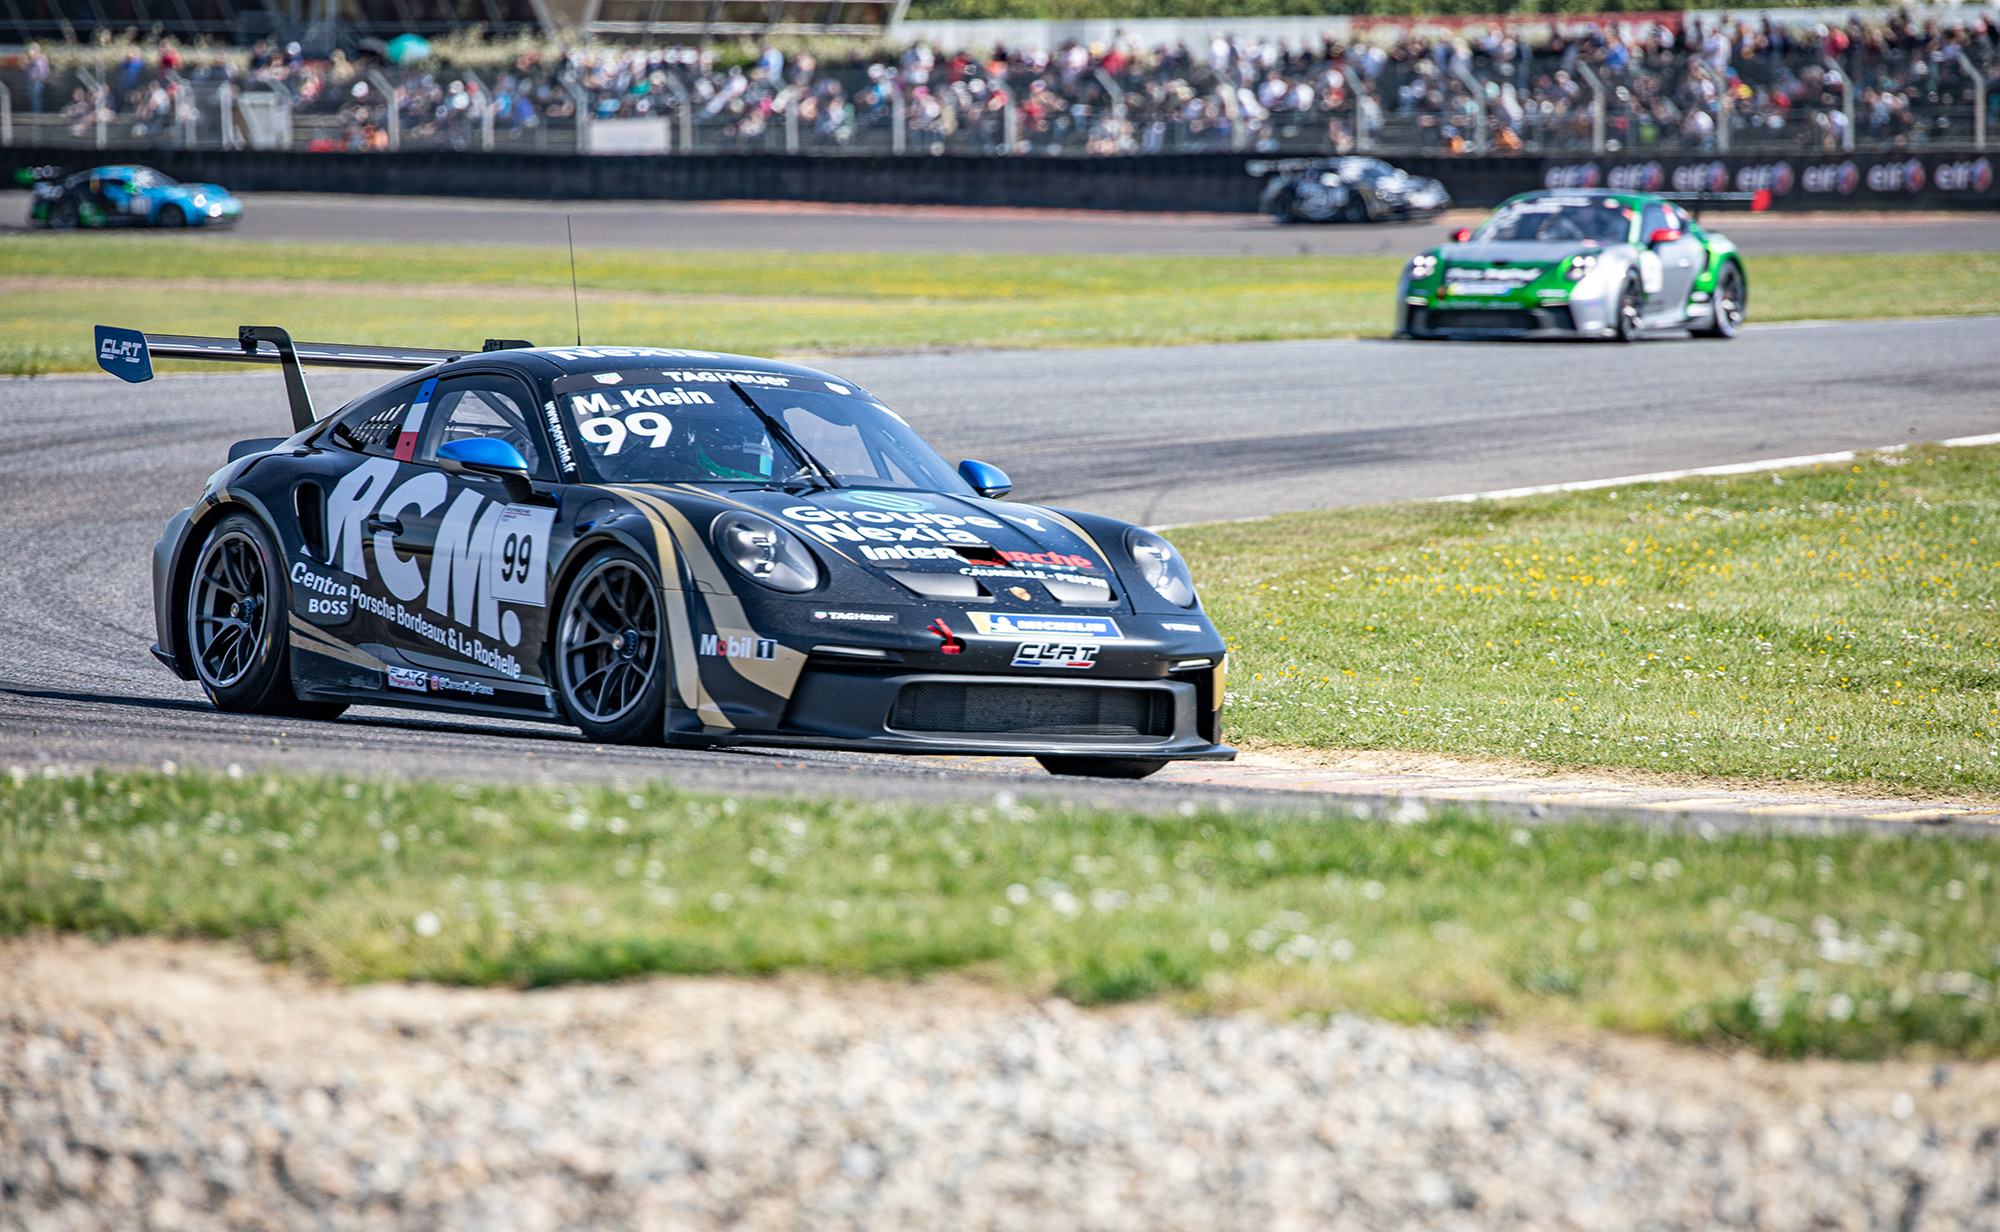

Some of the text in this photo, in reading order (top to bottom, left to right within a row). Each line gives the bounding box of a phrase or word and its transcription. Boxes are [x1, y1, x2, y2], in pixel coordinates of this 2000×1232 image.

[1544, 164, 1580, 189] elf
[1607, 164, 1642, 190] elf
[1671, 163, 1707, 191] elf
[1802, 163, 1838, 192] elf
[1867, 162, 1904, 191] elf
[1934, 160, 1973, 191] elf
[101, 338, 142, 357] CLRT
[572, 387, 715, 416] M. Klein
[543, 400, 577, 474] www.porsche.fr
[579, 411, 673, 456] 99
[782, 505, 1047, 532] Groupe Y
[500, 532, 533, 584] 99
[290, 561, 522, 680] Centre Porsche Bordeaux & La Rochelle
[308, 598, 349, 616] BOSS
[1016, 620, 1107, 633] MICHELIN
[700, 633, 752, 659] Mobil
[1015, 641, 1101, 662] CLRT
